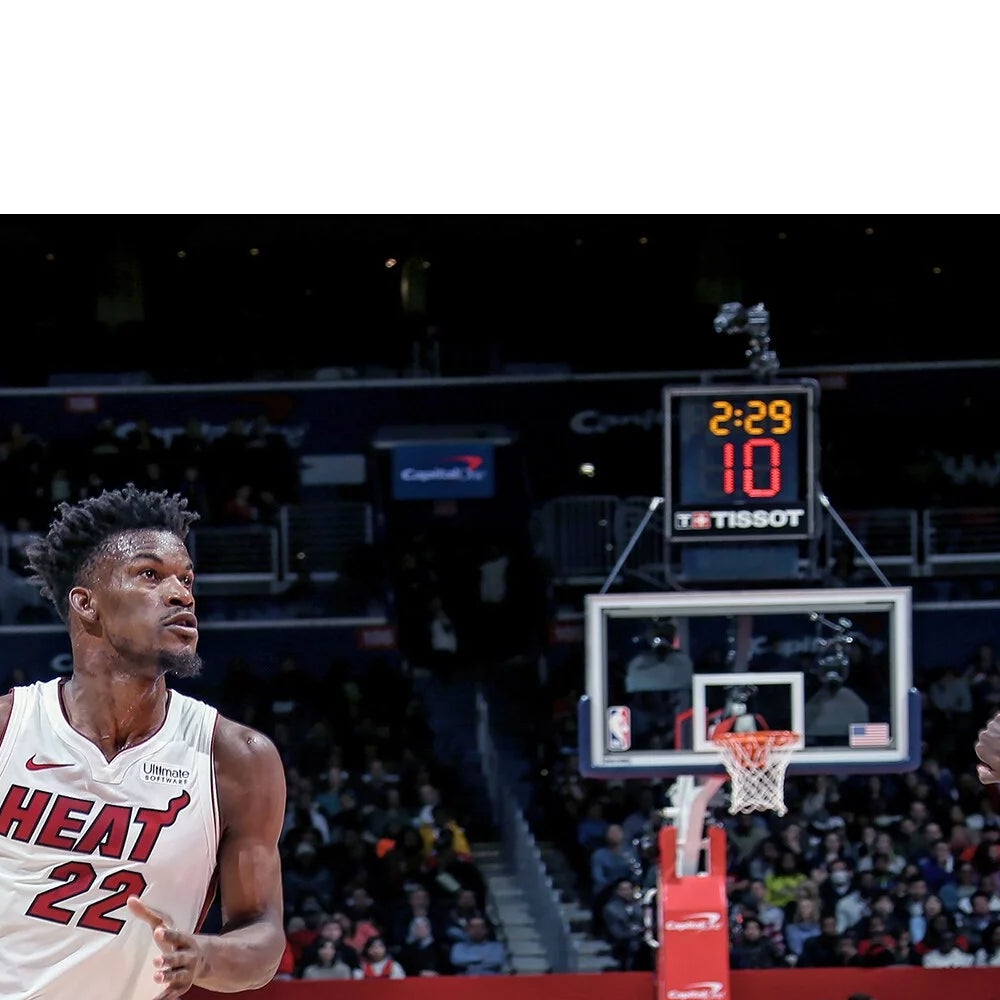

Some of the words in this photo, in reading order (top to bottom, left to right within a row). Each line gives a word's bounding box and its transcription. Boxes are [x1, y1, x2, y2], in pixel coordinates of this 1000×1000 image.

[709, 400, 792, 436] 2:29
[722, 437, 781, 498] 10
[711, 509, 804, 528] TISSOT
[143, 763, 190, 779] Ultimate
[145, 775, 188, 785] SOFTWARE
[25, 861, 147, 935] 22
